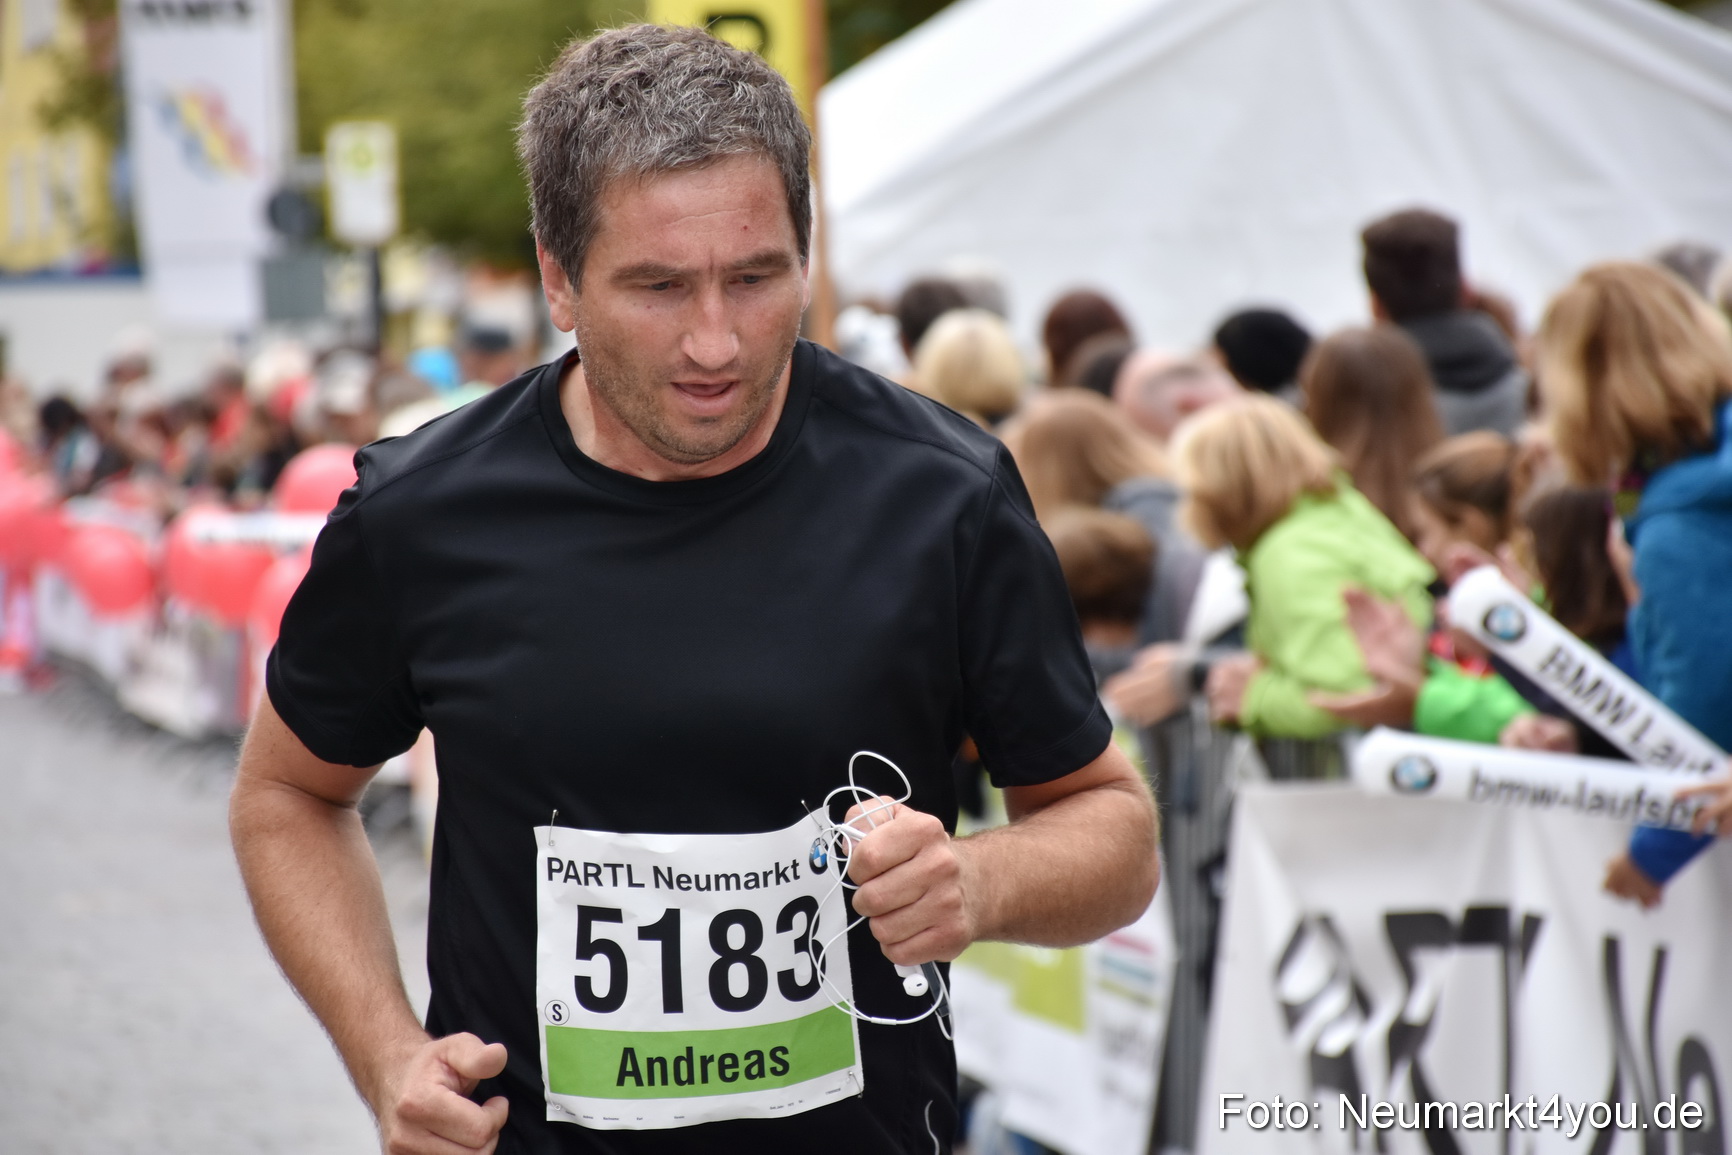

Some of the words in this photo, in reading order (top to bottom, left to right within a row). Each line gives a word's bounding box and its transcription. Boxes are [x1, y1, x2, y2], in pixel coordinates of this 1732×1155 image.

[1537, 644, 1638, 727] BMW
[547, 857, 645, 888] PARTL
[653, 859, 801, 891] Neumarkt
[573, 895, 828, 1014] 5183
[552, 1003, 563, 1022] S
[615, 1045, 790, 1087] Andreas
